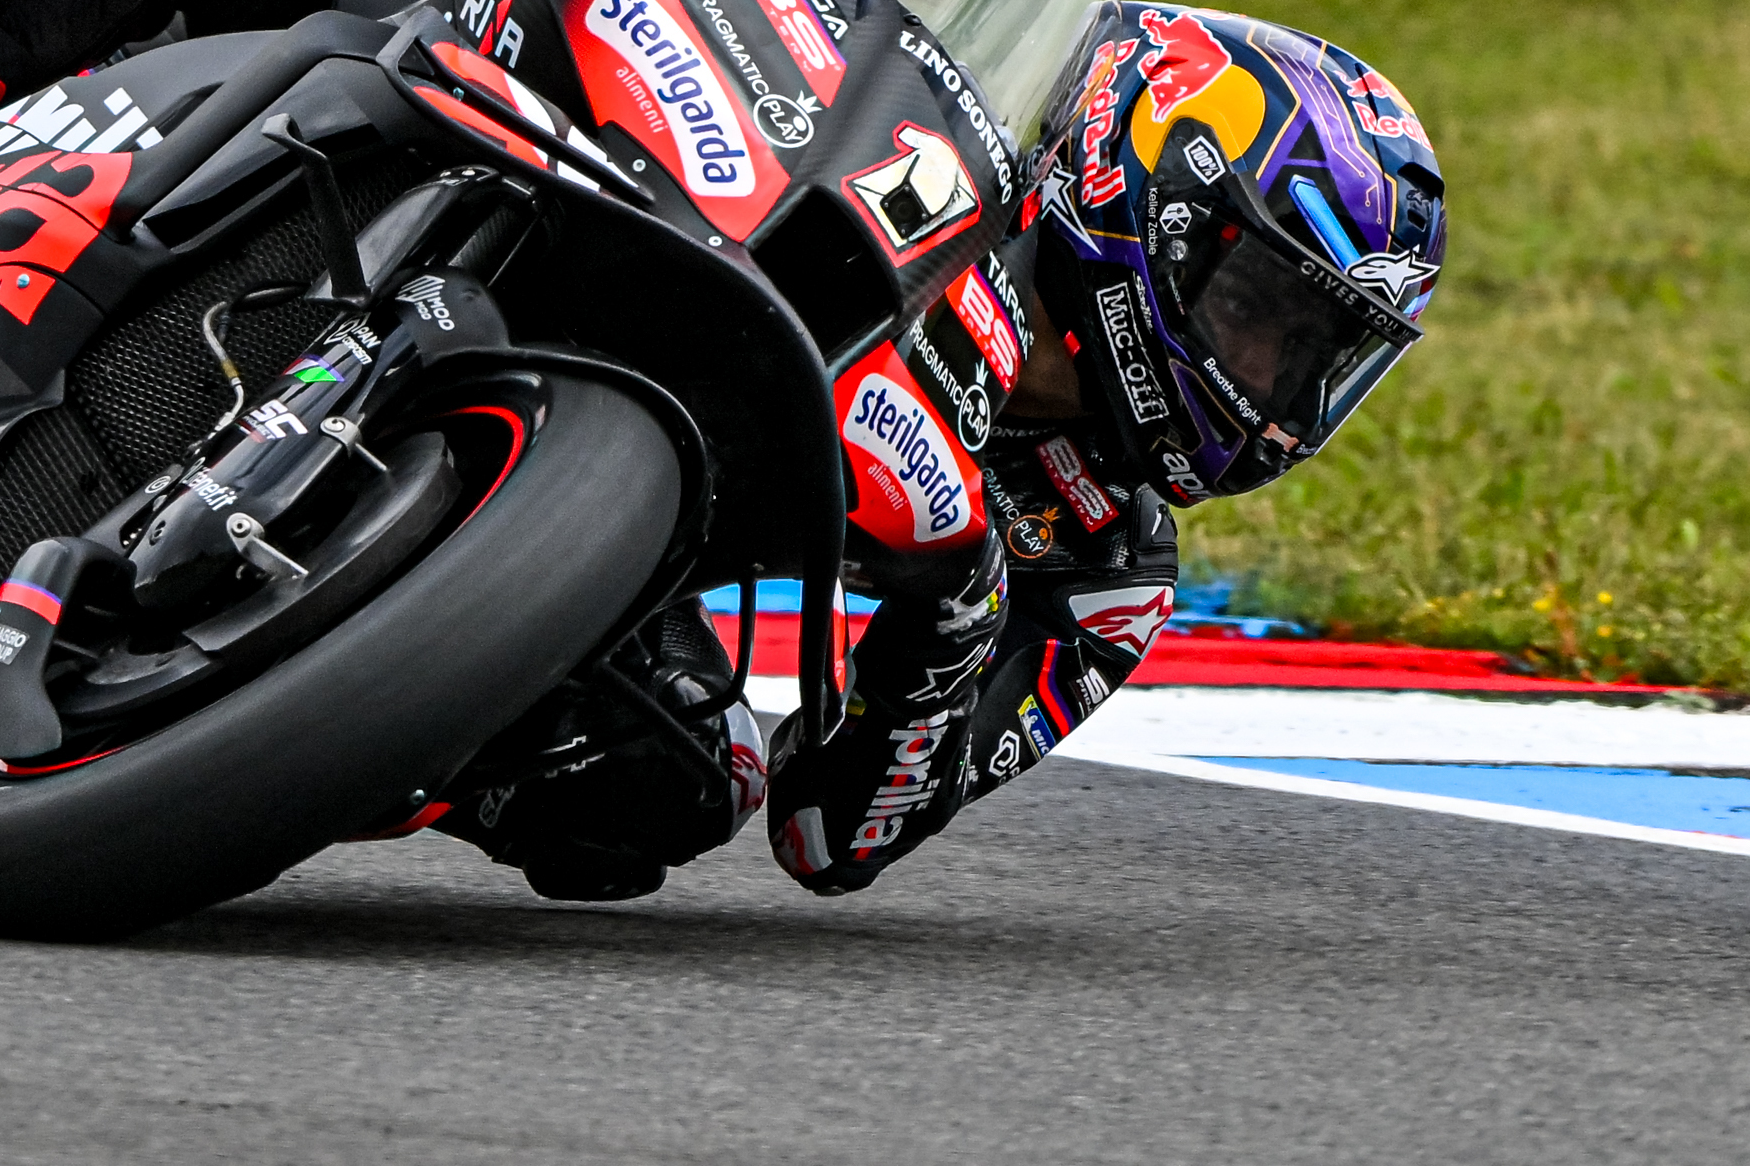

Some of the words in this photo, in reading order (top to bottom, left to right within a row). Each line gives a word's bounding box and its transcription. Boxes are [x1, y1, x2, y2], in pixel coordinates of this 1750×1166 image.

[615, 66, 670, 133] alimenti
[763, 99, 802, 143] PLAY
[900, 31, 961, 92] LINO
[957, 92, 1013, 205] SONEGO
[1189, 140, 1221, 178] 100%
[1146, 187, 1159, 219] Keller
[1146, 221, 1160, 255] Zable
[1300, 260, 1357, 305] GIVES
[355, 324, 381, 349] PAN
[431, 295, 456, 332] MOD
[960, 273, 1017, 377] BS
[908, 320, 962, 405] PRAGMATIC
[963, 396, 988, 438] PLAY
[1102, 290, 1165, 419] Muc-Off
[1203, 357, 1239, 403] Breathe
[1235, 395, 1262, 426] Right
[250, 399, 308, 438] SC
[854, 388, 962, 533] sterilgarda
[867, 462, 909, 512] alimenti
[982, 466, 1020, 521] GMATIC
[1014, 520, 1045, 553] PLAY
